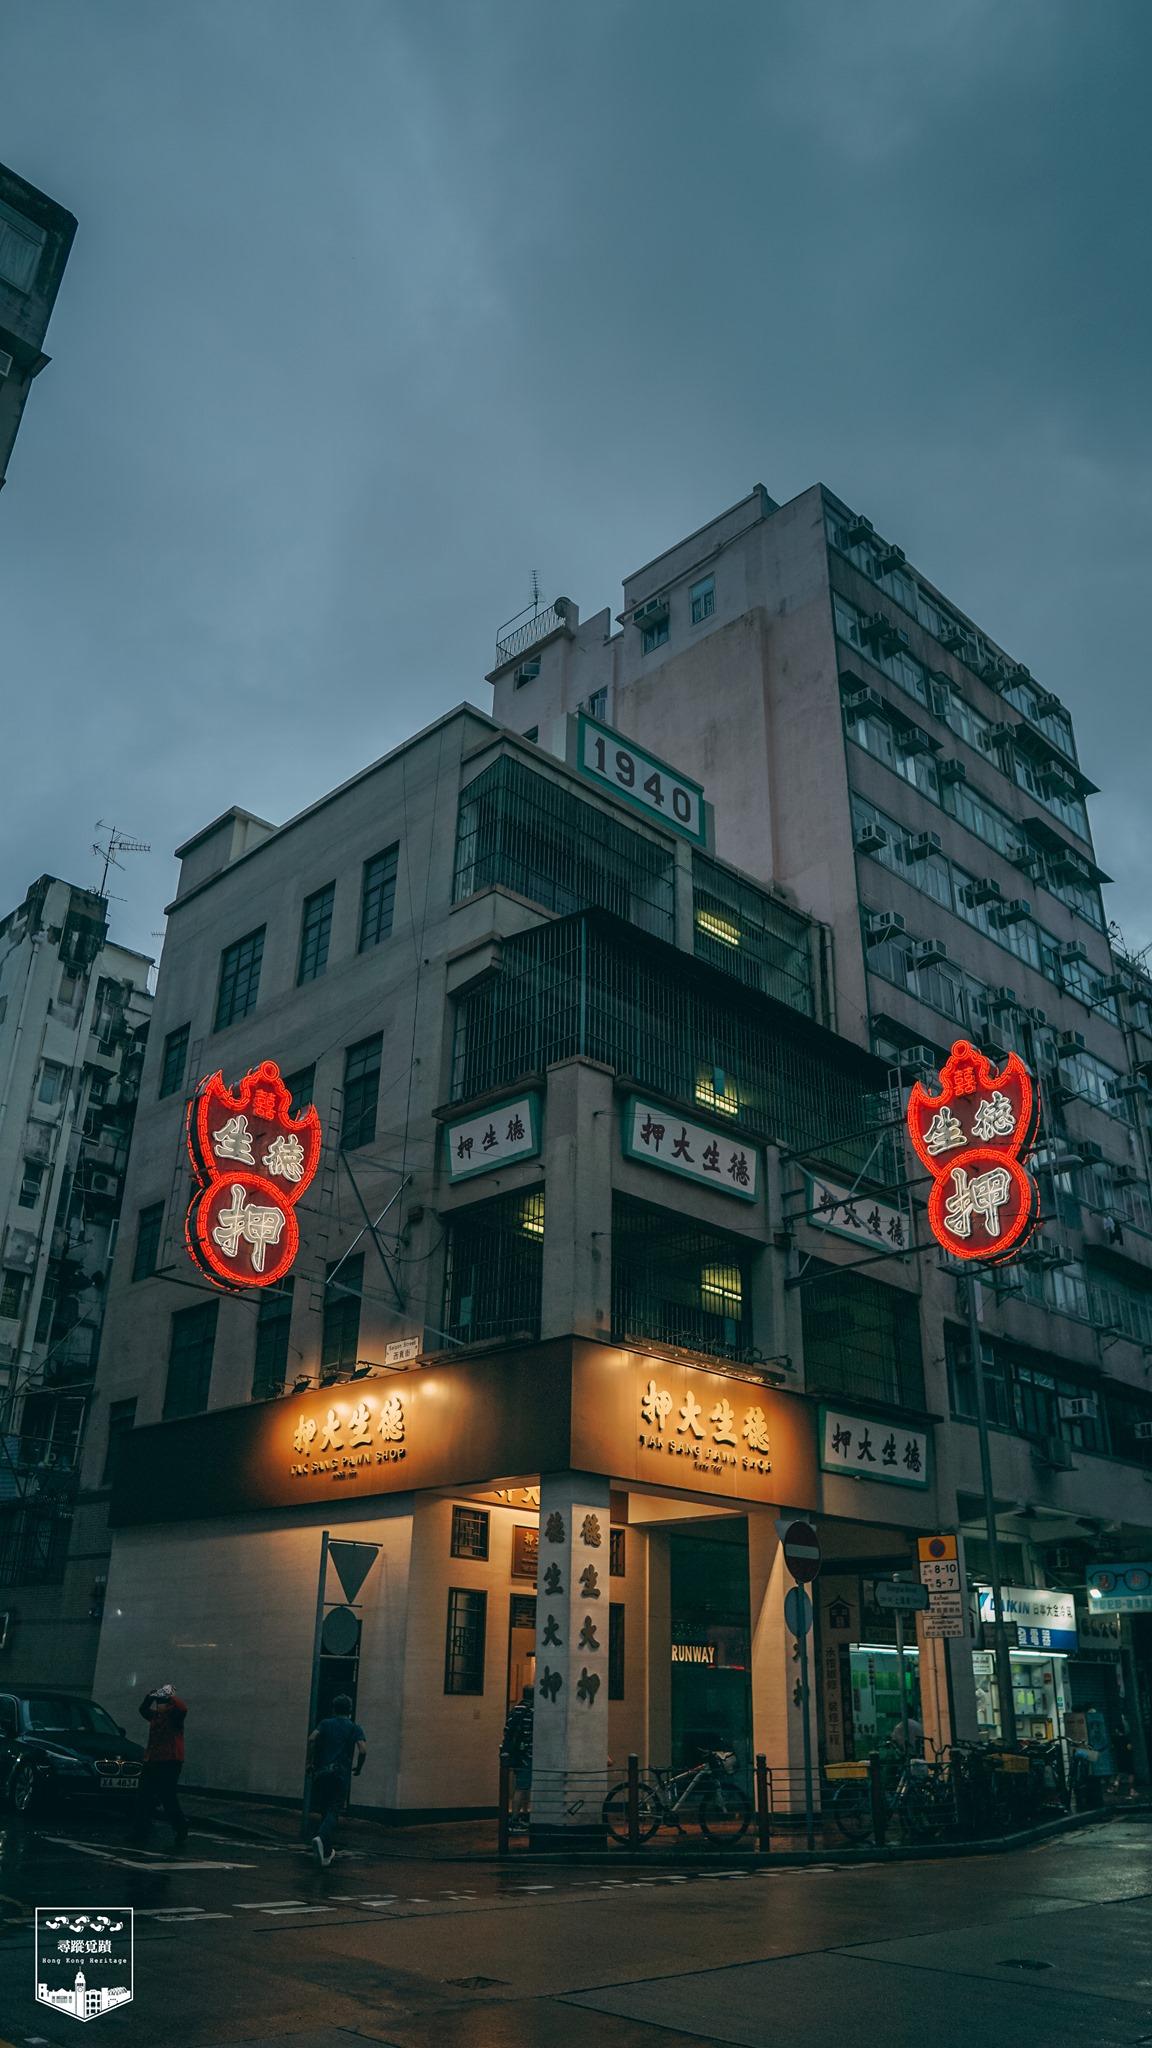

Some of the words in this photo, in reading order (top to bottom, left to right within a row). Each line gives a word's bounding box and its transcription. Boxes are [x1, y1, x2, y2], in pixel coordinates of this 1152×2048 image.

[594, 736, 691, 823] 1940
[943, 1167, 1013, 1238] 押
[211, 1183, 287, 1273] 押
[375, 1448, 407, 1464] SHOP
[639, 1433, 664, 1452] TAK
[668, 1439, 702, 1458] SANG
[705, 1448, 738, 1468] PAWN
[741, 1456, 773, 1475] SHOP
[934, 1563, 957, 1574] 8-10
[671, 1644, 715, 1663] RUNWAY
